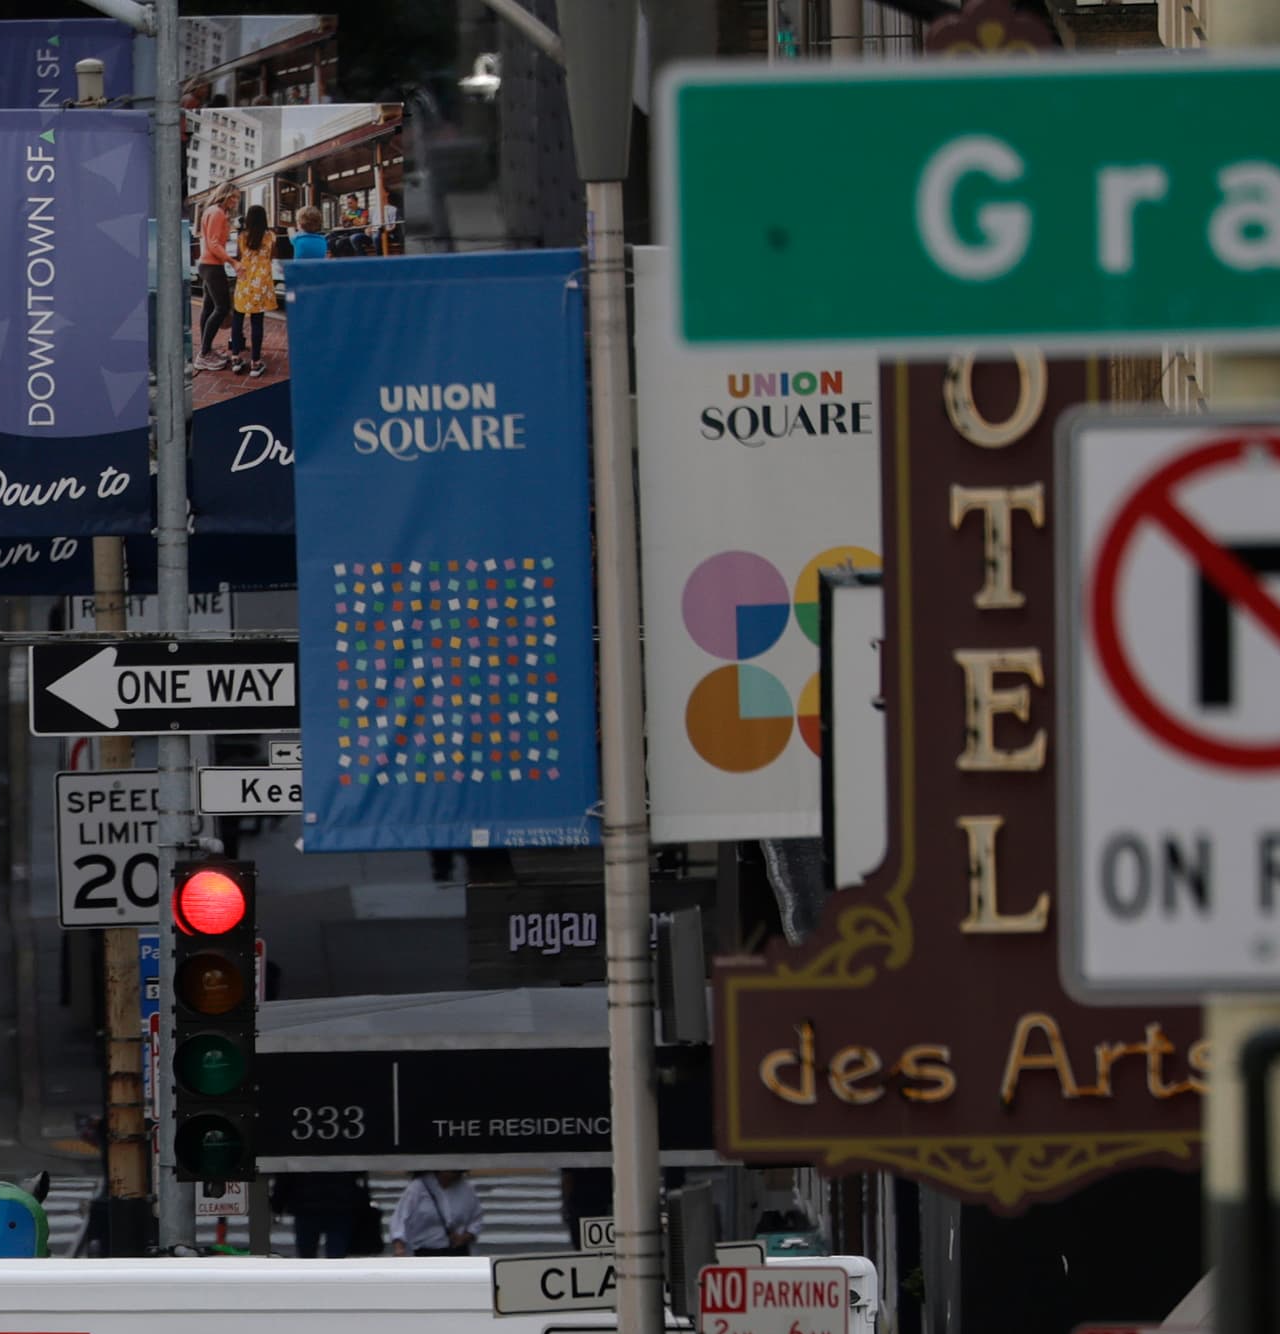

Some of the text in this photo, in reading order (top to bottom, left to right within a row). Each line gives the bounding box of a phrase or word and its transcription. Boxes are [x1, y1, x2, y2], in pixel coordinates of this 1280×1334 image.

[36, 48, 61, 78] SF
[26, 146, 56, 184] SF
[26, 196, 56, 427] DOWNTOWN
[379, 382, 497, 414] UNION
[727, 370, 844, 398] UNION
[352, 413, 527, 462] SQUARE
[699, 401, 873, 448] SQUARE
[96, 465, 131, 497] to
[48, 536, 80, 562] to
[941, 350, 1052, 936] OTEL
[117, 668, 284, 705] ONE WAY
[79, 821, 158, 845] LIMIT
[73, 852, 159, 909] 20
[1099, 829, 1214, 924] ON
[508, 912, 598, 956] pagan
[759, 1011, 1214, 1108] des Arts
[290, 1105, 366, 1141] 333
[432, 1115, 611, 1138] THE RESIDENC
[540, 1265, 616, 1300] CLA
[703, 1270, 840, 1310] NO PARKING
